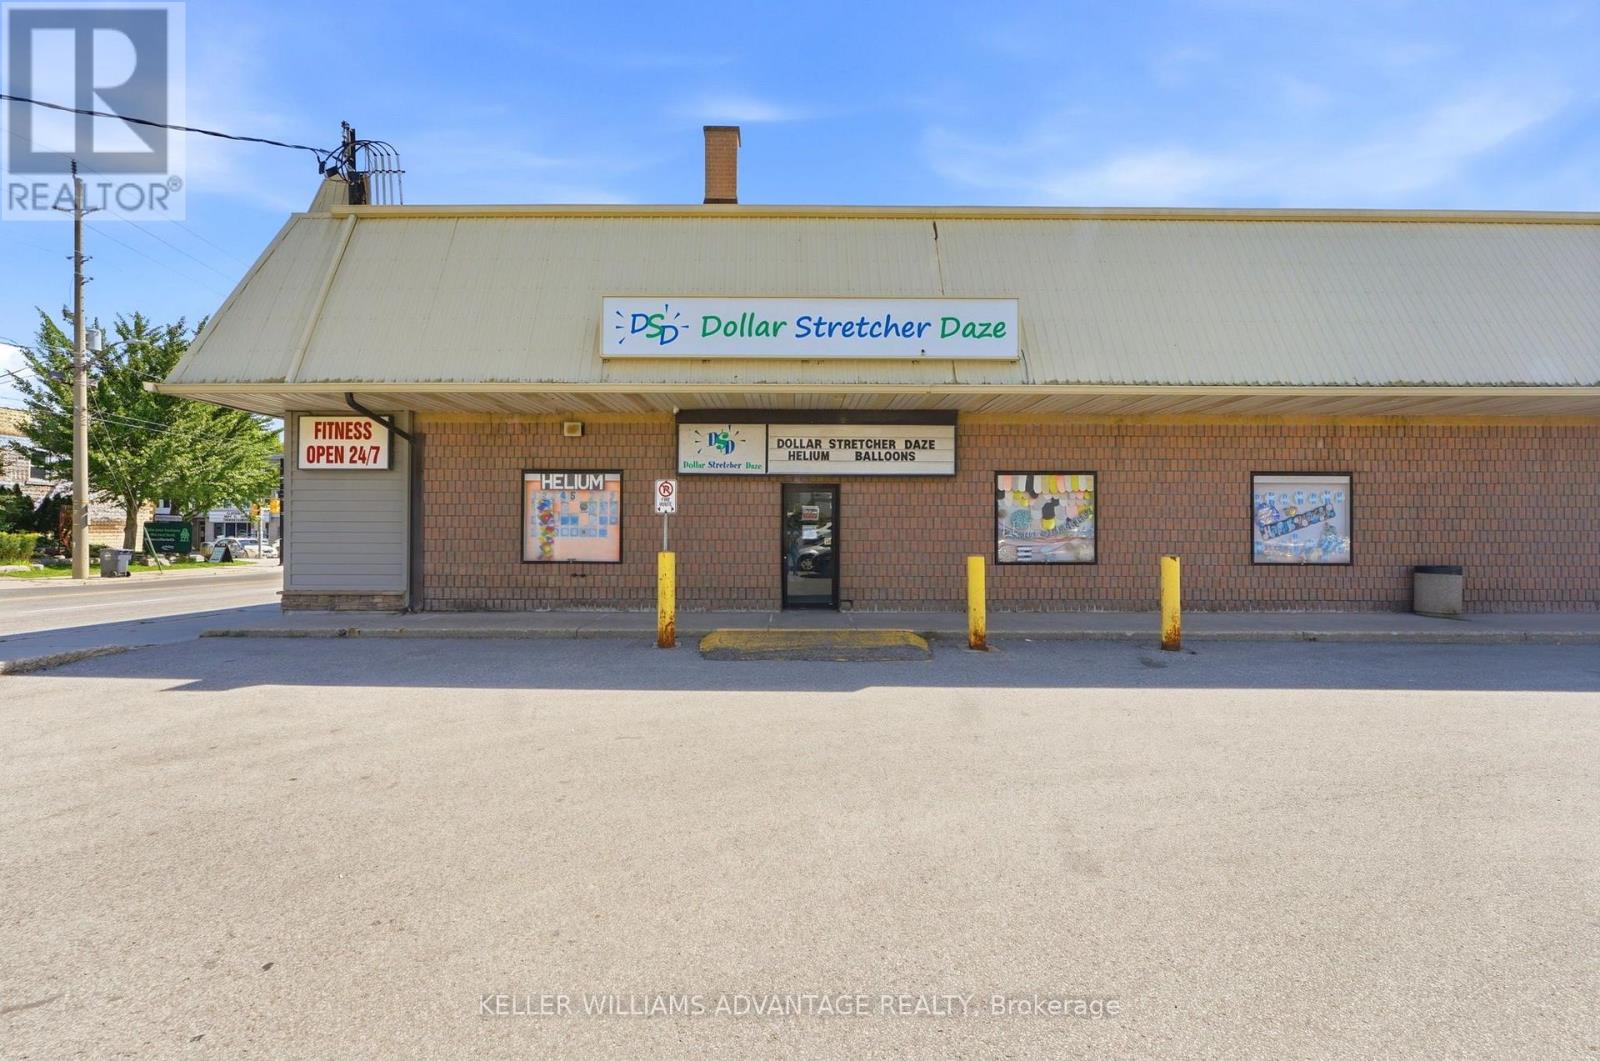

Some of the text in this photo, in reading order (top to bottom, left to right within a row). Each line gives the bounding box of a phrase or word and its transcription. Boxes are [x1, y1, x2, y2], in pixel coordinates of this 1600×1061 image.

[630, 313, 679, 345] DSD
[700, 312, 1007, 339] Dollar Stretcher Daze
[314, 421, 372, 440] FITNESS
[708, 429, 736, 455] DSD
[776, 438, 936, 450] DOLLAR STRETCHER DAZE
[306, 445, 381, 466] OPEN 24/7
[787, 450, 916, 462] HELIUM BALLOONS
[682, 460, 763, 471] Dollar Stretcher Daze
[541, 473, 603, 490] HELIUM
